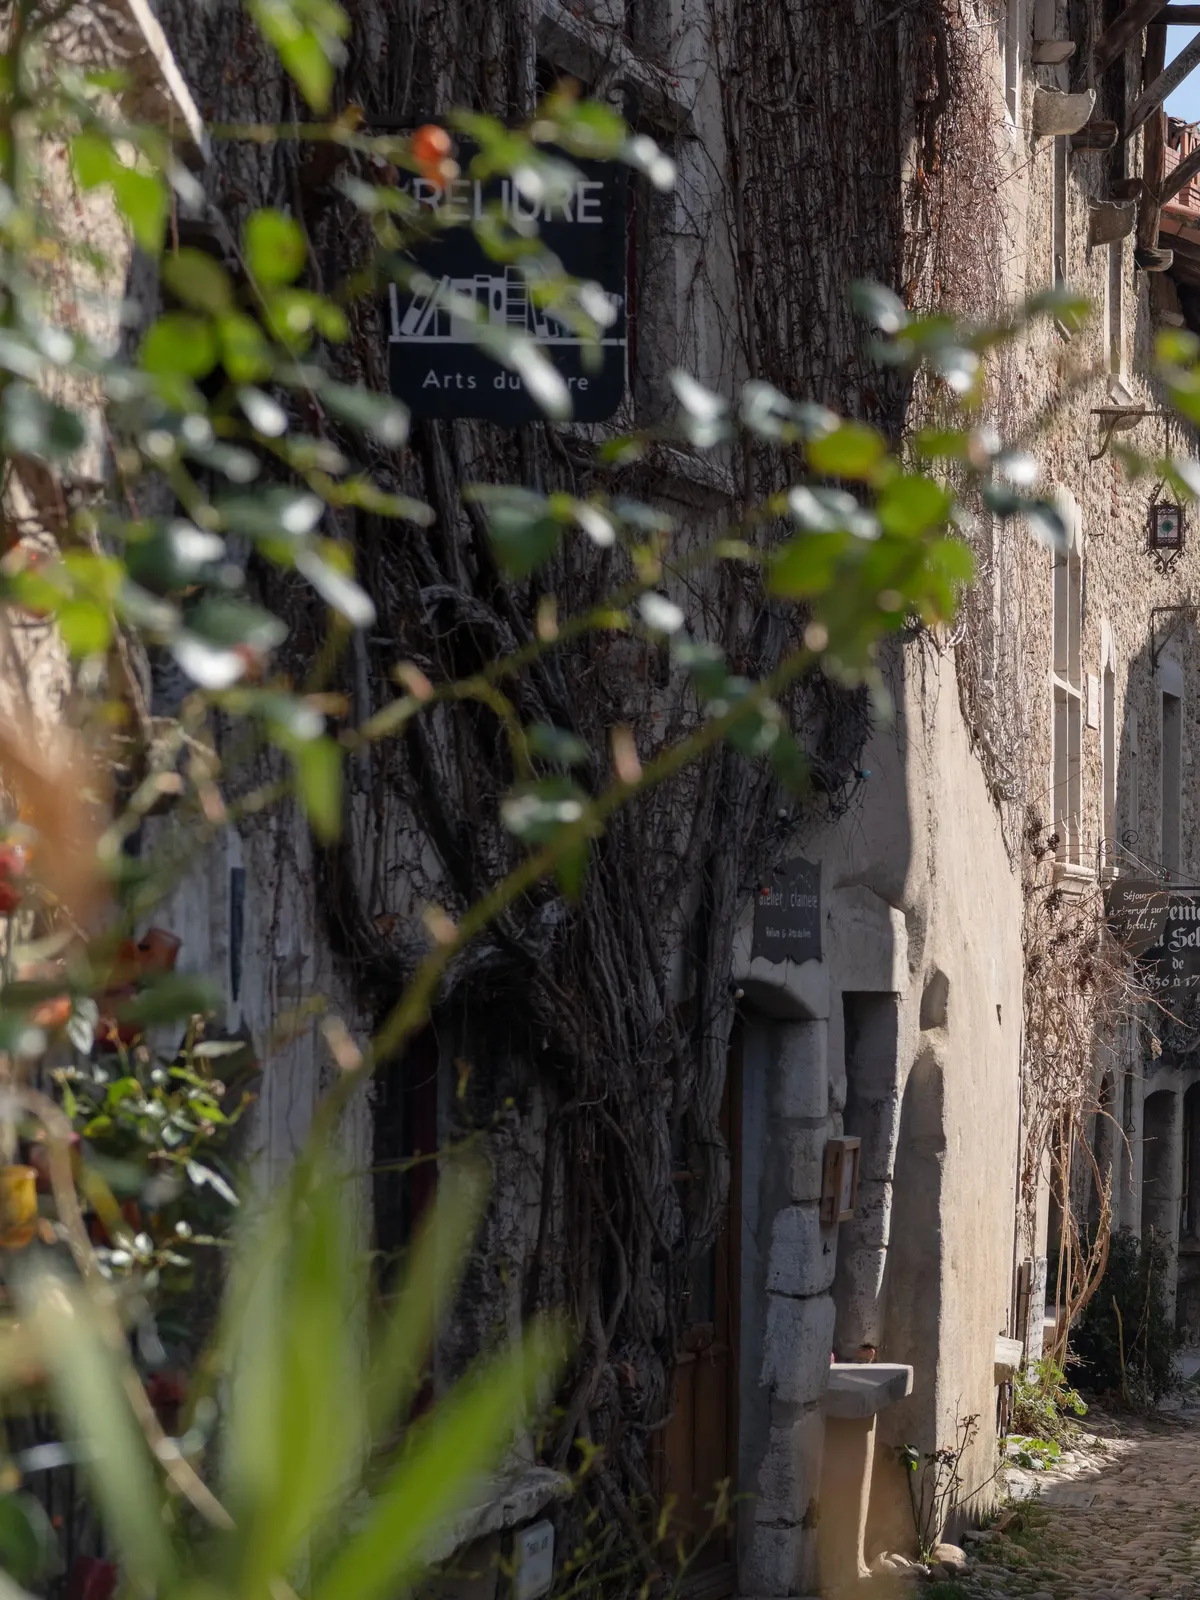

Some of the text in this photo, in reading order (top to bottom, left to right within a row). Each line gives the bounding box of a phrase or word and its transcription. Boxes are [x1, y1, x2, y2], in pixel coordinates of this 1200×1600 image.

[421, 369, 477, 390] Arts
[493, 370, 522, 391] du
[1171, 956, 1185, 969] de
[1173, 974, 1181, 987] à
